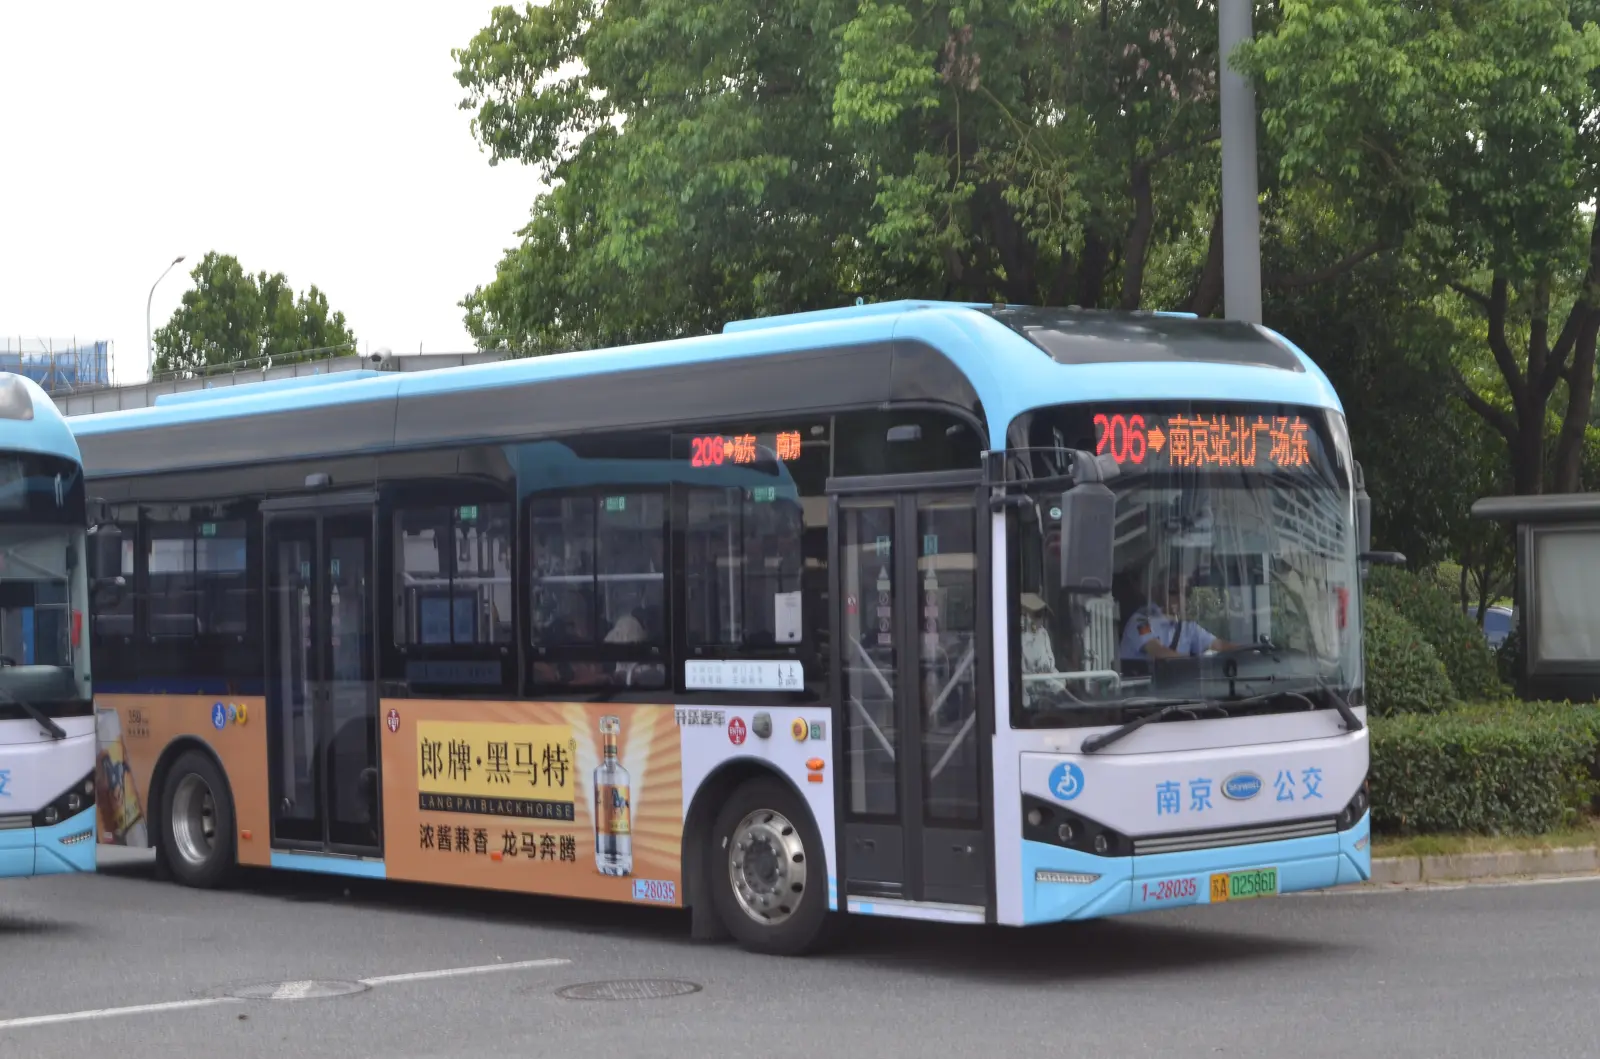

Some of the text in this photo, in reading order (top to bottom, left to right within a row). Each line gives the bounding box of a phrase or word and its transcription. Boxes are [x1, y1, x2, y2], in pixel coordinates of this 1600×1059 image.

[691, 436, 724, 467] 206
[1093, 413, 1309, 467] 206 南京站北广场东
[421, 795, 572, 818] LANG PAI BLACK HORSE
[1156, 766, 1323, 816] 南京 公交
[419, 823, 576, 863] 浓酱兼香 龙马奔腾
[632, 880, 676, 901] 1-28035
[1141, 878, 1197, 901] 1-28035
